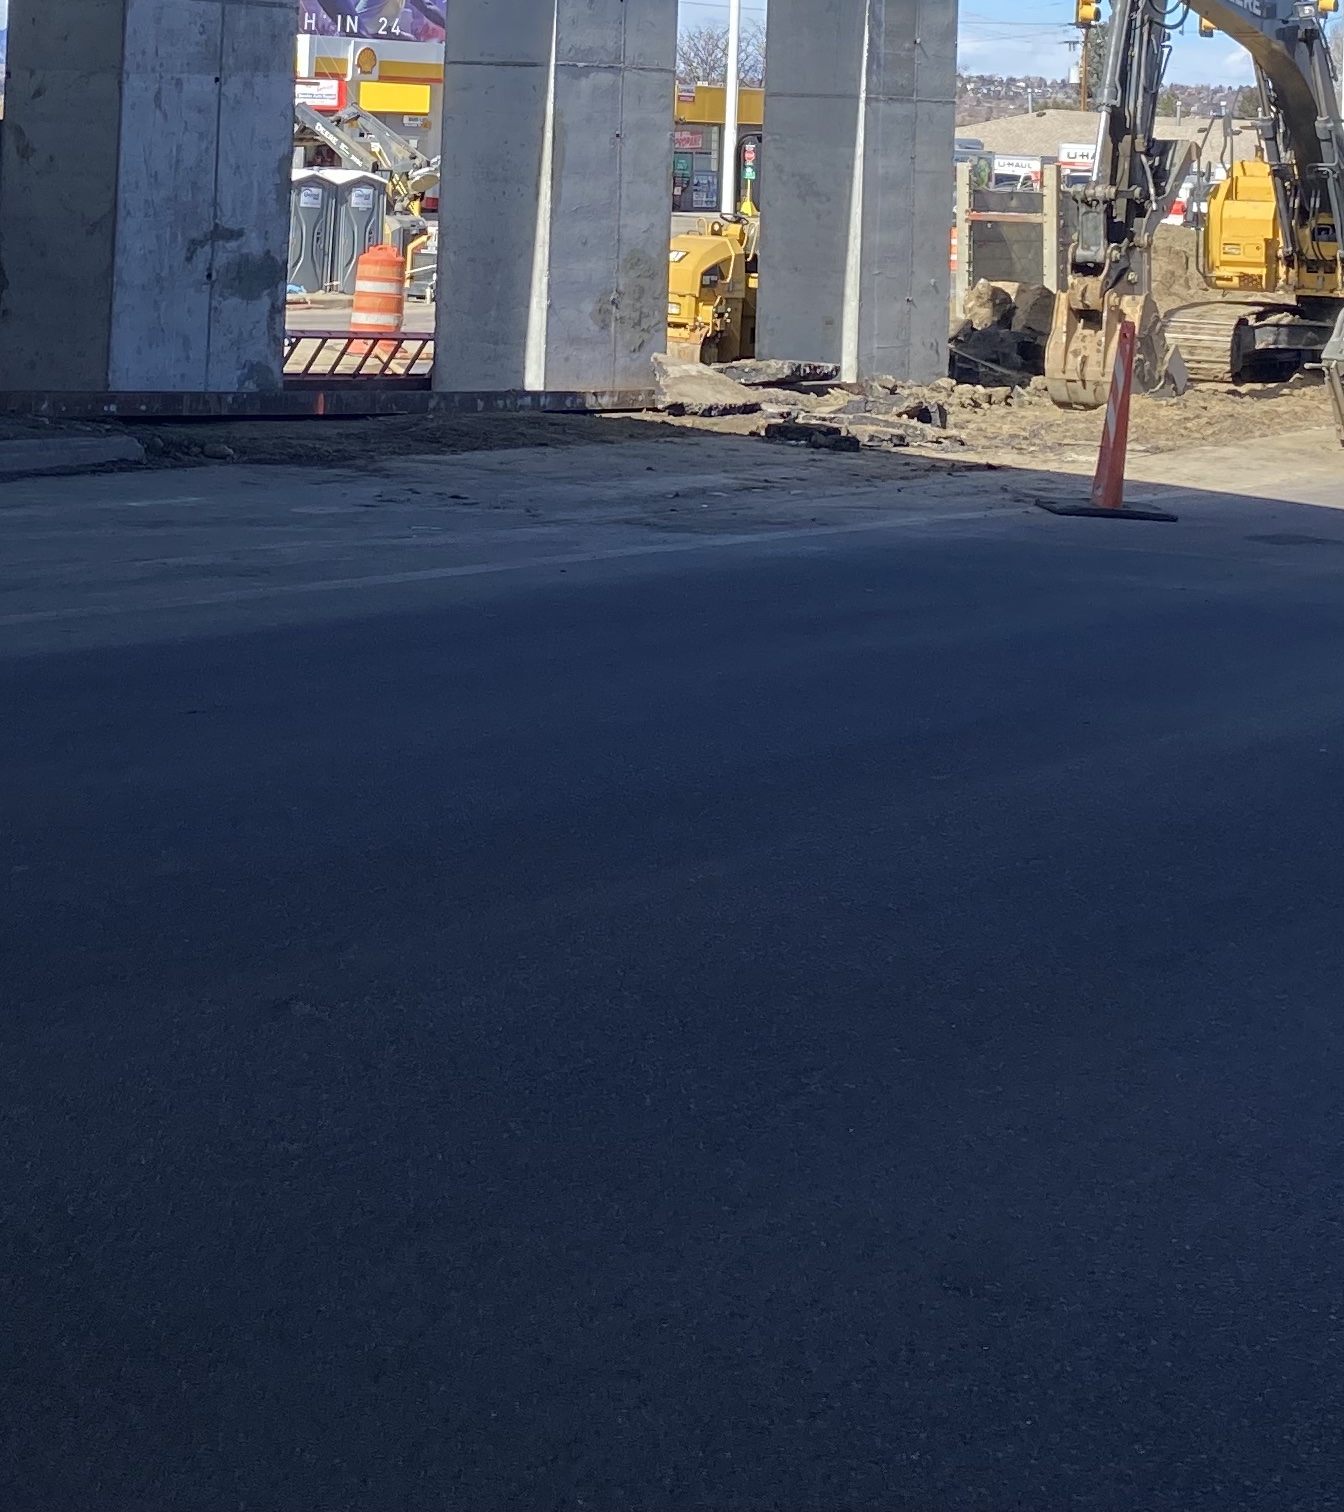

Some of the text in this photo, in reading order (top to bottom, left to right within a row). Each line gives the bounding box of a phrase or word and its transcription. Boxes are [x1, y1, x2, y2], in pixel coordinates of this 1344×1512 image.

[337, 14, 359, 33] IN
[377, 17, 401, 36] 24
[315, 121, 339, 146] DEERE
